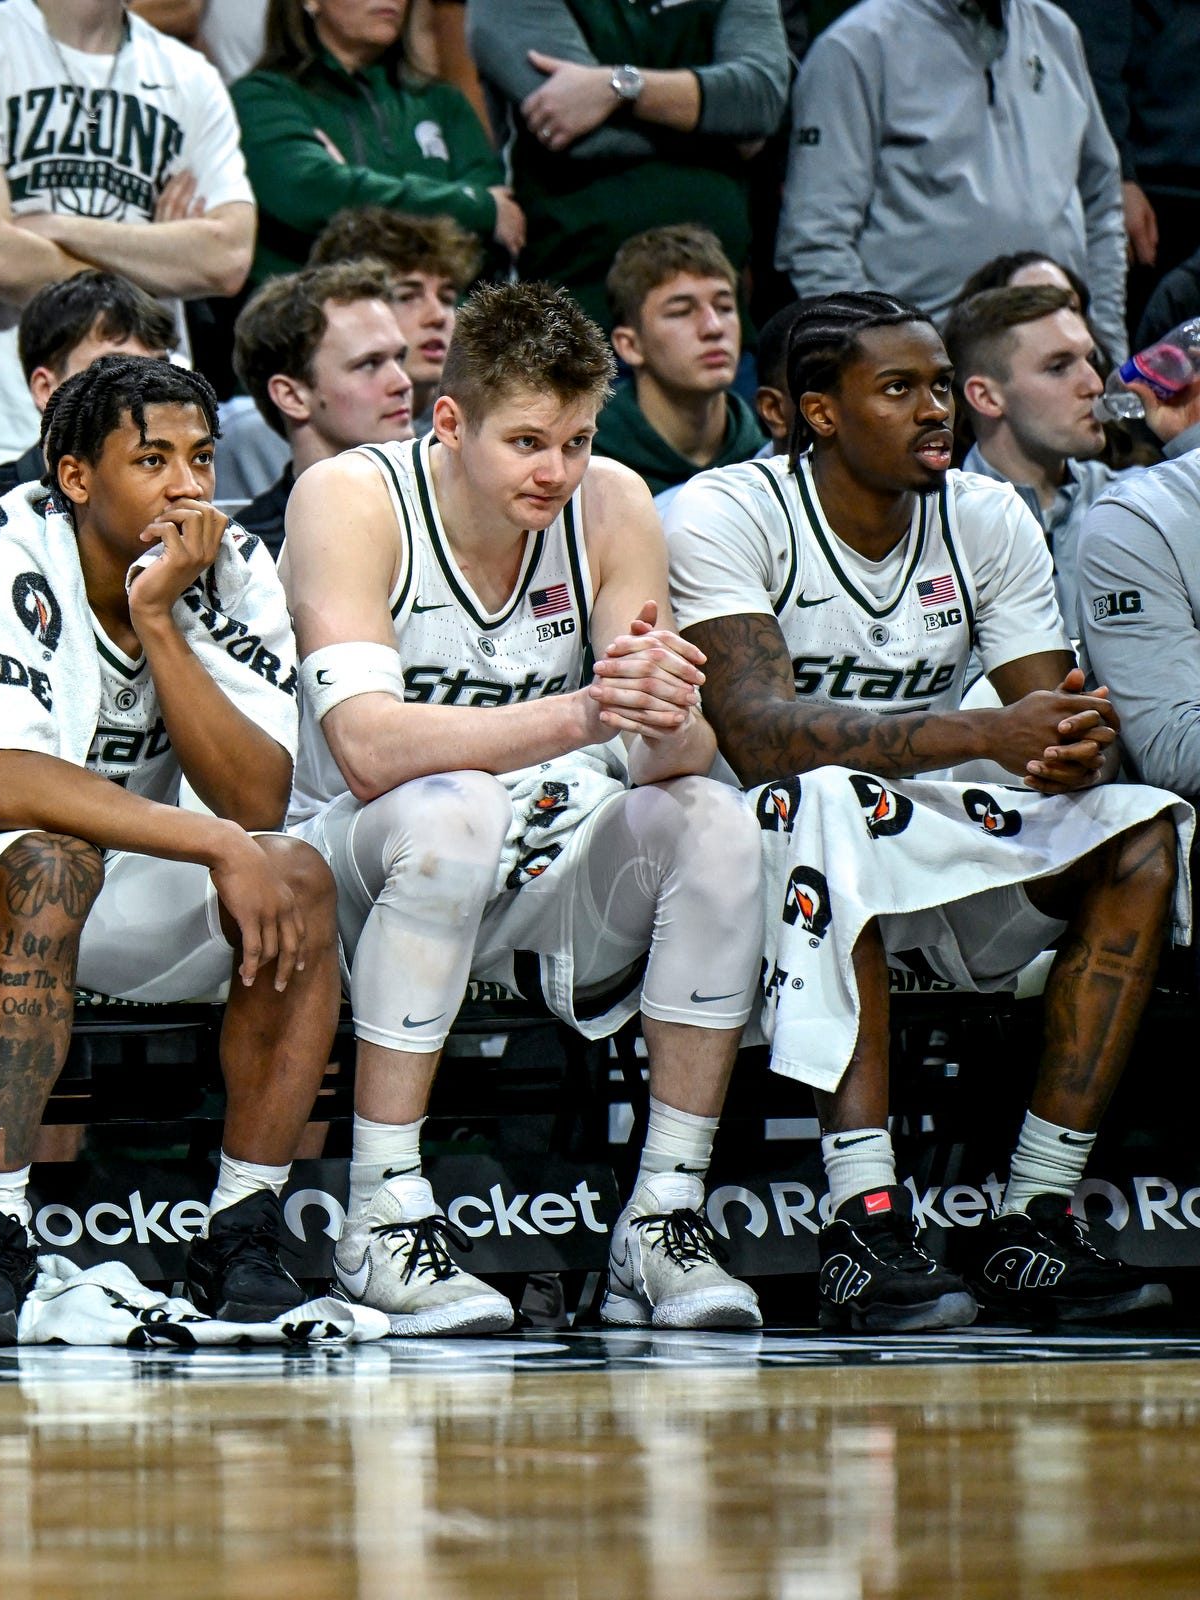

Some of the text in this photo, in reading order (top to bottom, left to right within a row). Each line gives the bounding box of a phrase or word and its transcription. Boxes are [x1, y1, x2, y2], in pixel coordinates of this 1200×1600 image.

[792, 655, 957, 700] State
[34, 969, 58, 989] The
[2, 996, 43, 1017] Odds
[25, 1189, 211, 1247] ocke
[436, 1179, 609, 1238] cket
[769, 1172, 1007, 1236] Rket
[820, 1253, 872, 1304] AIR
[984, 1246, 1065, 1290] AIR
